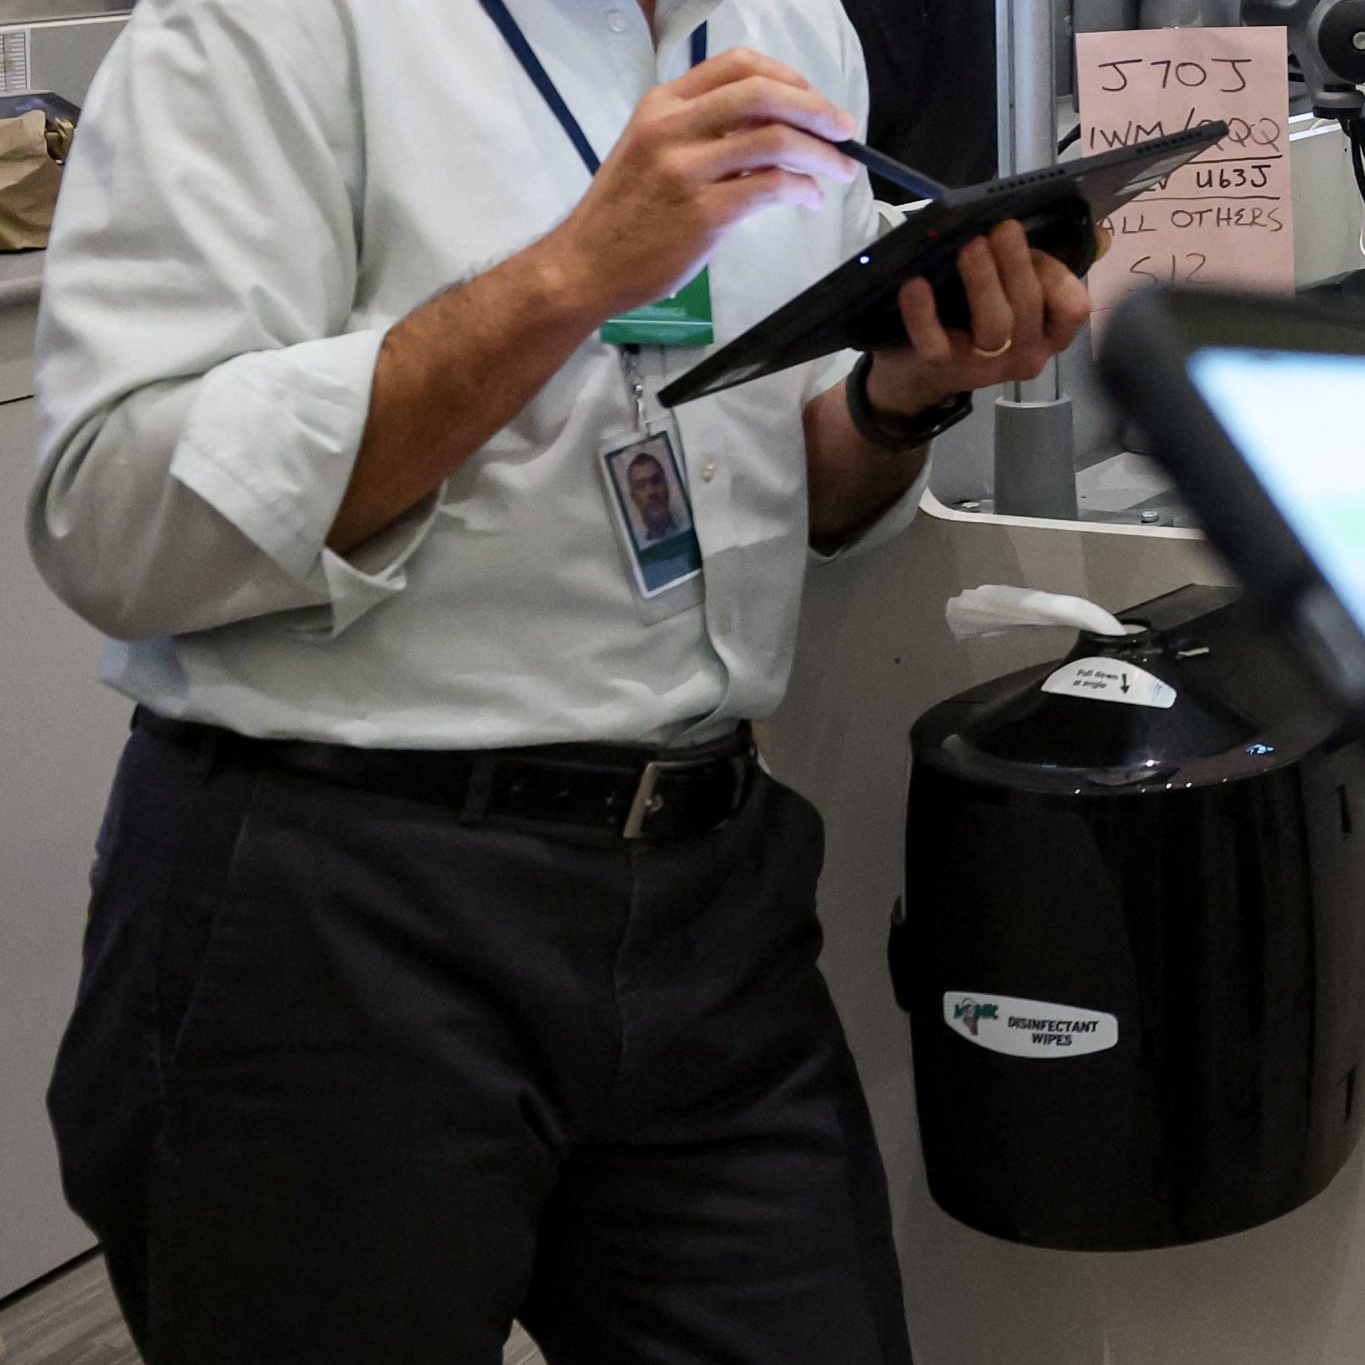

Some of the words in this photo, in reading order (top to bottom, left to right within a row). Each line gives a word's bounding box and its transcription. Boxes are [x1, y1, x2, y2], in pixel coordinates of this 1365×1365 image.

[1097, 213, 1157, 236] ALL
[1171, 207, 1283, 232] OTHERS
[1007, 1016, 1100, 1033] DISINFECTANT
[1031, 1032, 1073, 1046] WIPES
